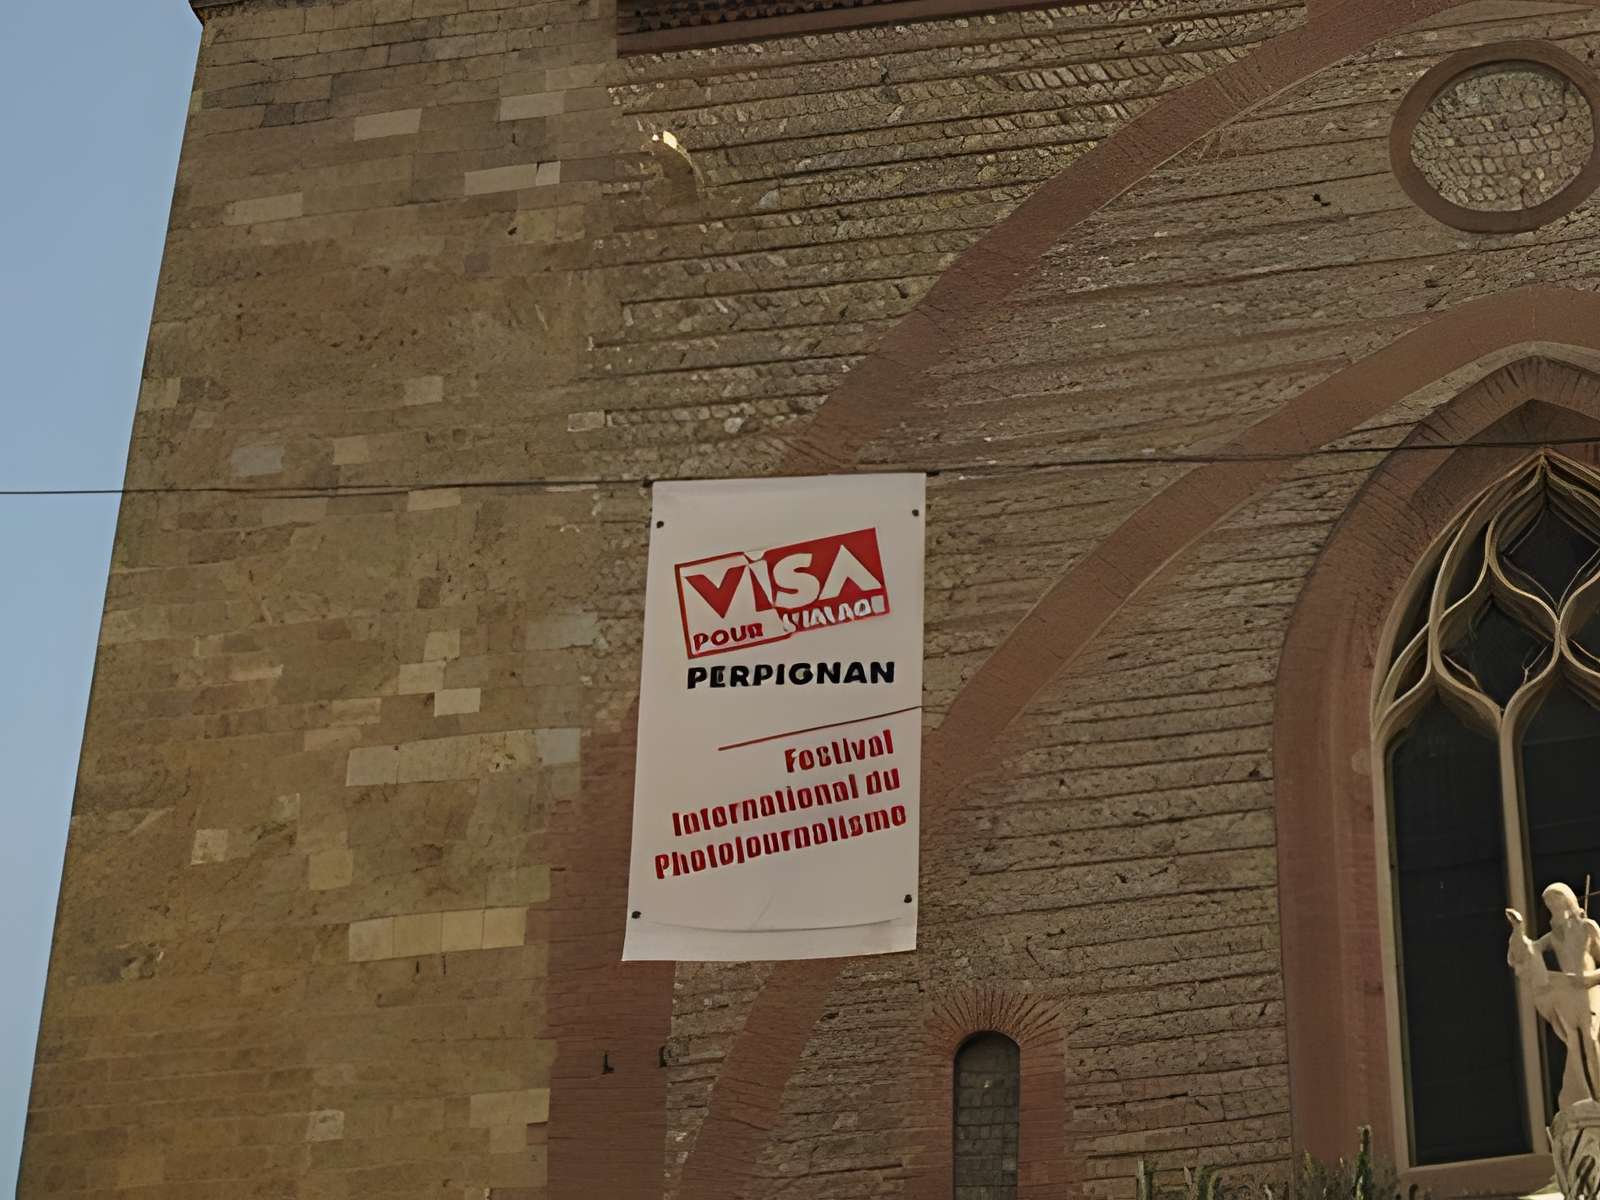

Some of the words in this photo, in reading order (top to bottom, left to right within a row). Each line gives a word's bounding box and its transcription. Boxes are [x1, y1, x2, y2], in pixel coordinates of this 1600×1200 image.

[692, 622, 764, 651] POUR
[686, 661, 895, 690] PERPIGNAN
[783, 728, 894, 773] Festival
[671, 773, 860, 837] International
[865, 767, 901, 796] du
[654, 804, 907, 880] Photojournalisme
